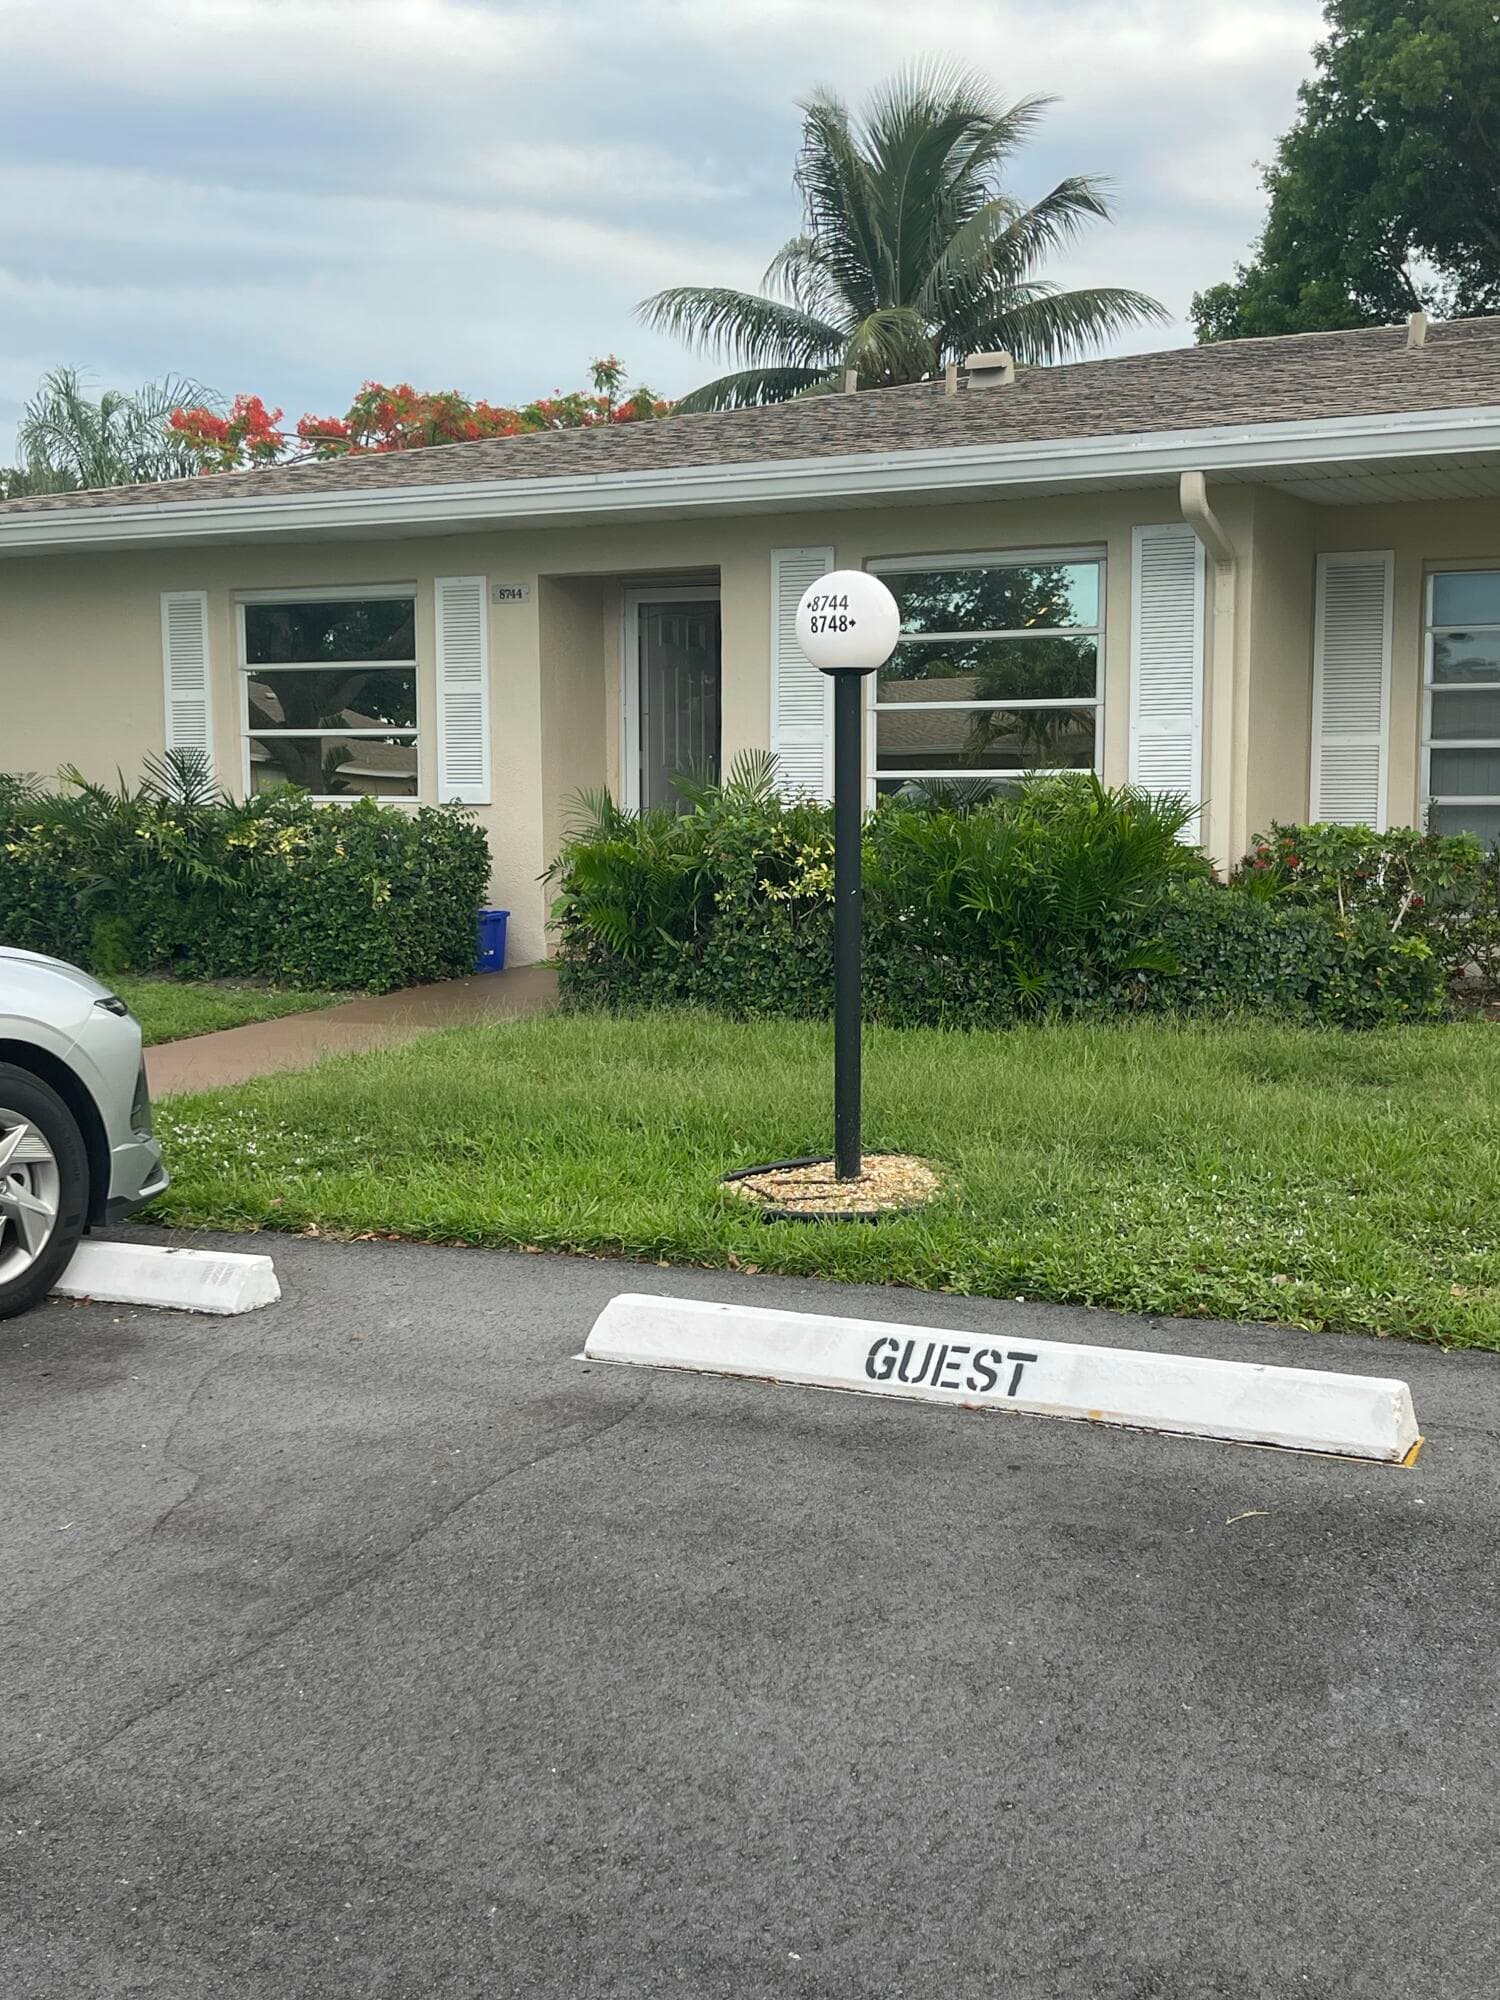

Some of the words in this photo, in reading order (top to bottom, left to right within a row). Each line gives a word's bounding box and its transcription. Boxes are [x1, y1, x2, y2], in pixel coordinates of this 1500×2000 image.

[499, 588, 522, 600] 8744
[811, 595, 849, 612] 8744
[810, 615, 848, 633] 8748
[865, 1337, 1038, 1397] GUEST
